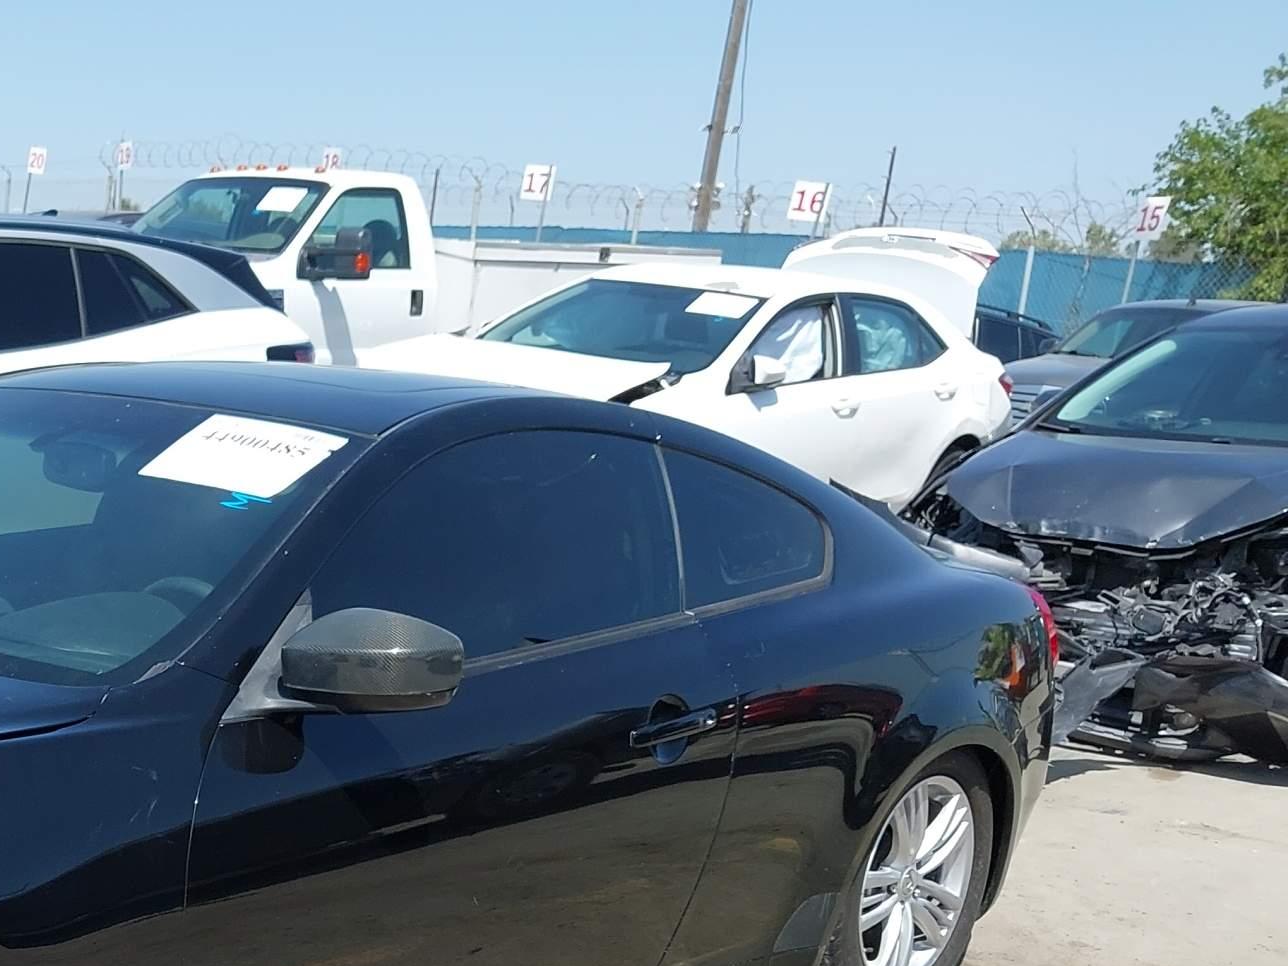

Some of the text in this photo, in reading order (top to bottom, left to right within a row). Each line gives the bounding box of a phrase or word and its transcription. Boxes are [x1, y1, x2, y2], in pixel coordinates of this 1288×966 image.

[30, 153, 44, 168] 20
[524, 172, 550, 193] 17
[792, 190, 826, 214] 16
[1137, 205, 1163, 232] 15
